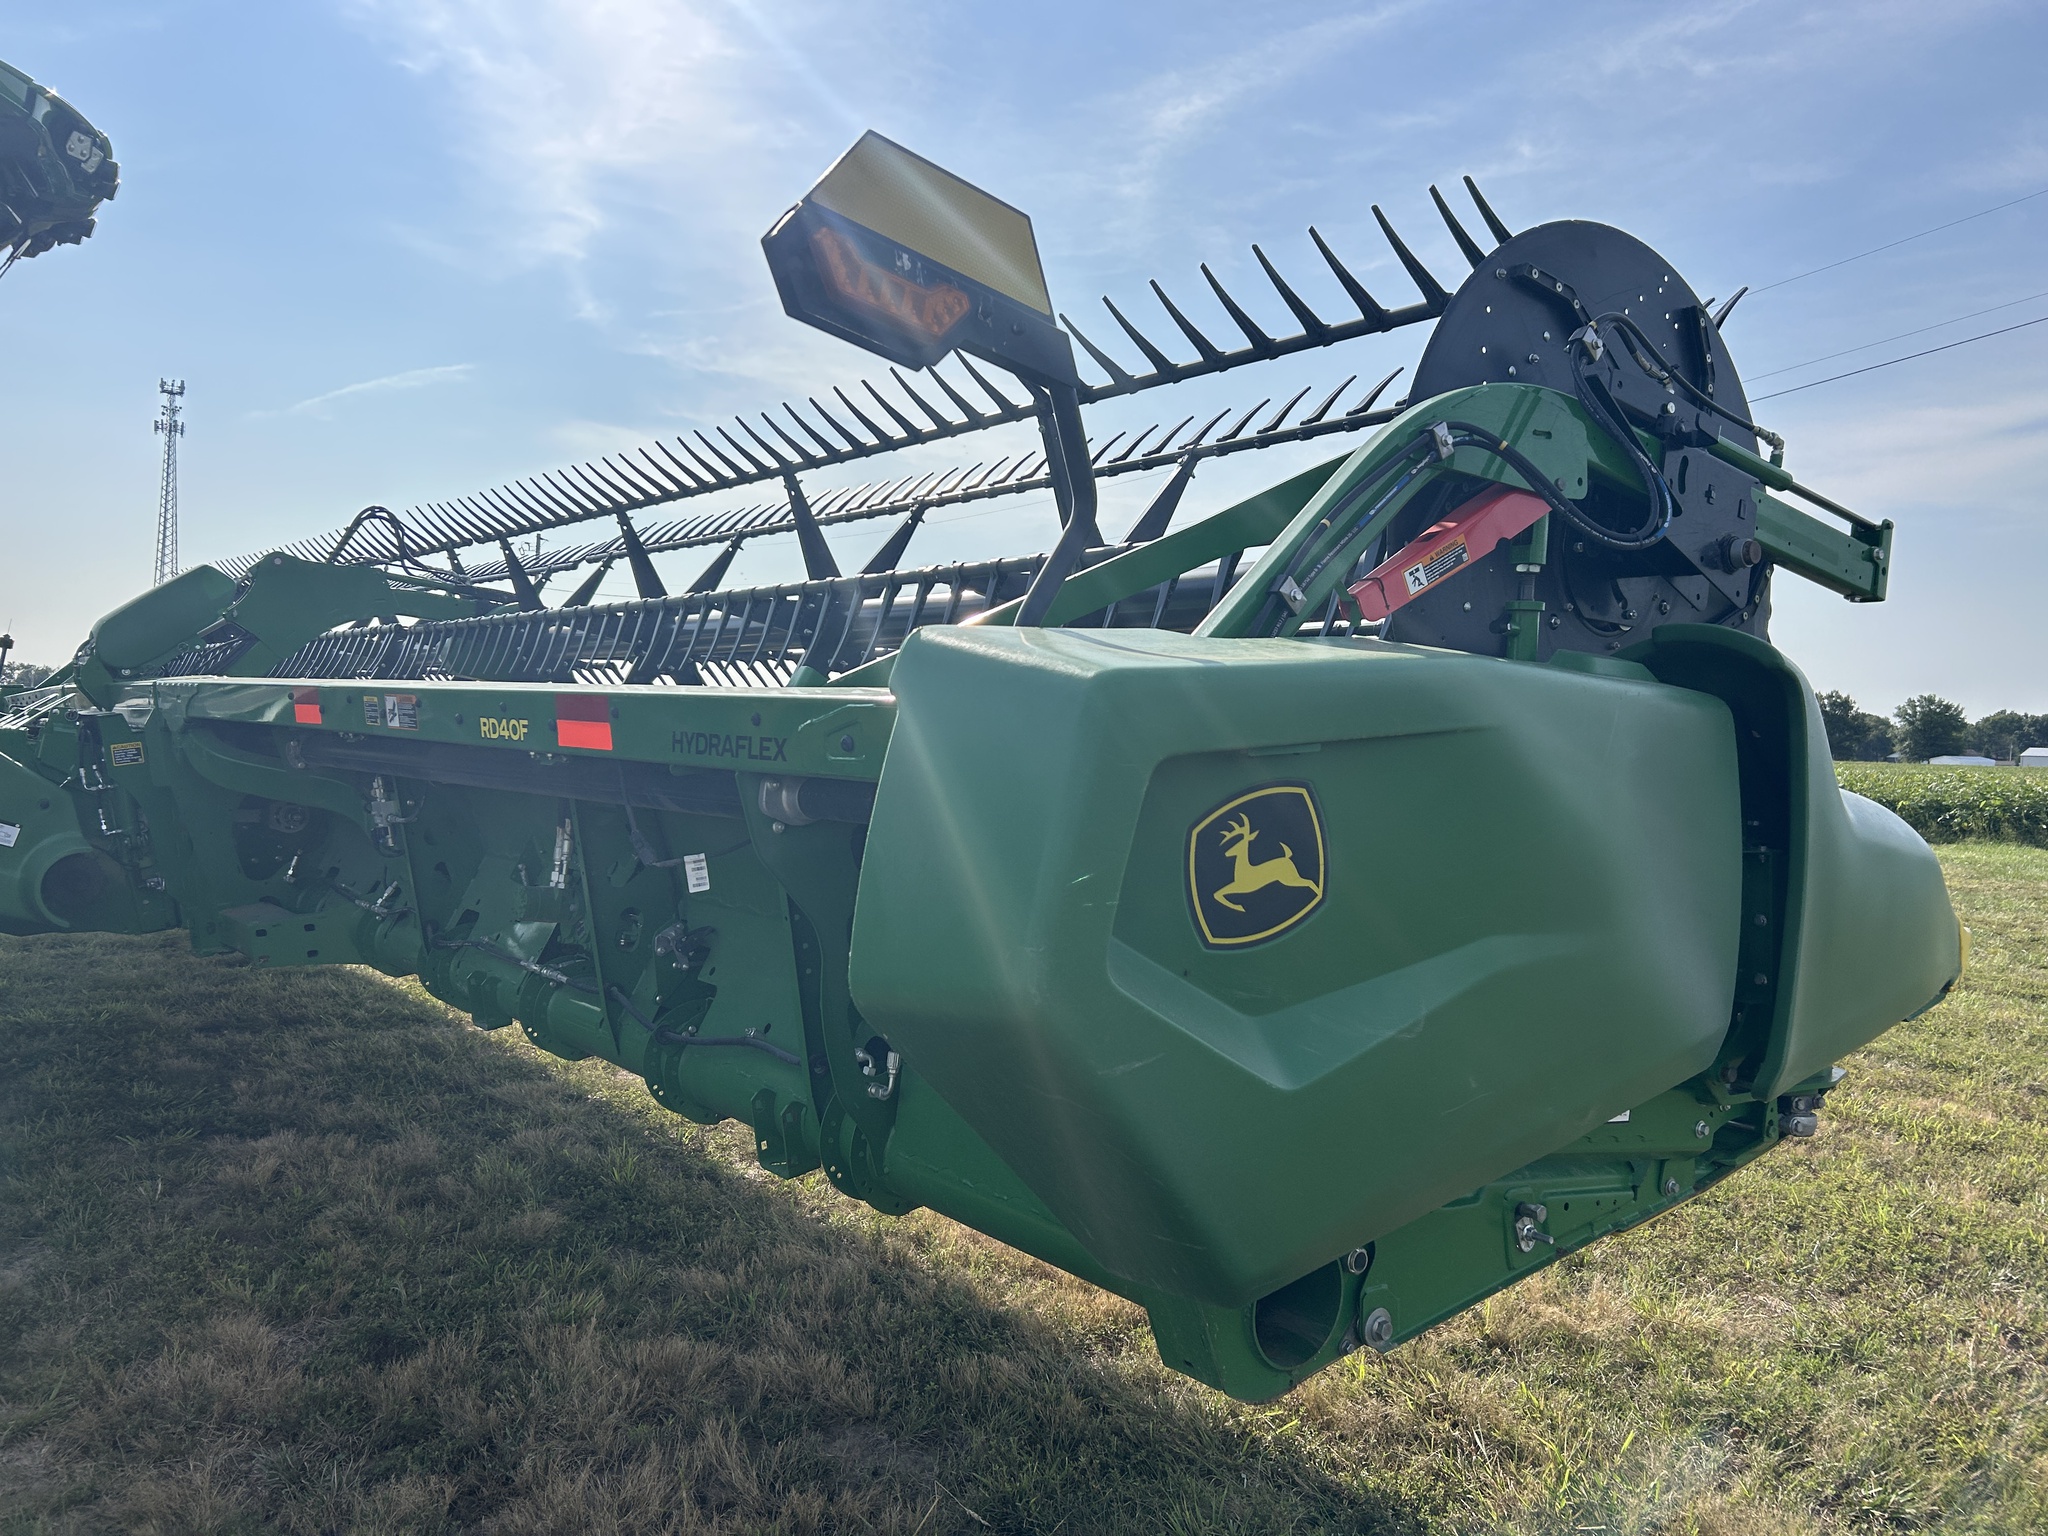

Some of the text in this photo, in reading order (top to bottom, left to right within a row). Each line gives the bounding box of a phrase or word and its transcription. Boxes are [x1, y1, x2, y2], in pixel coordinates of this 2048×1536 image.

[1435, 540, 1458, 557] WARNING
[480, 717, 528, 741] RD40F
[671, 731, 788, 762] HYDRAFLEX
